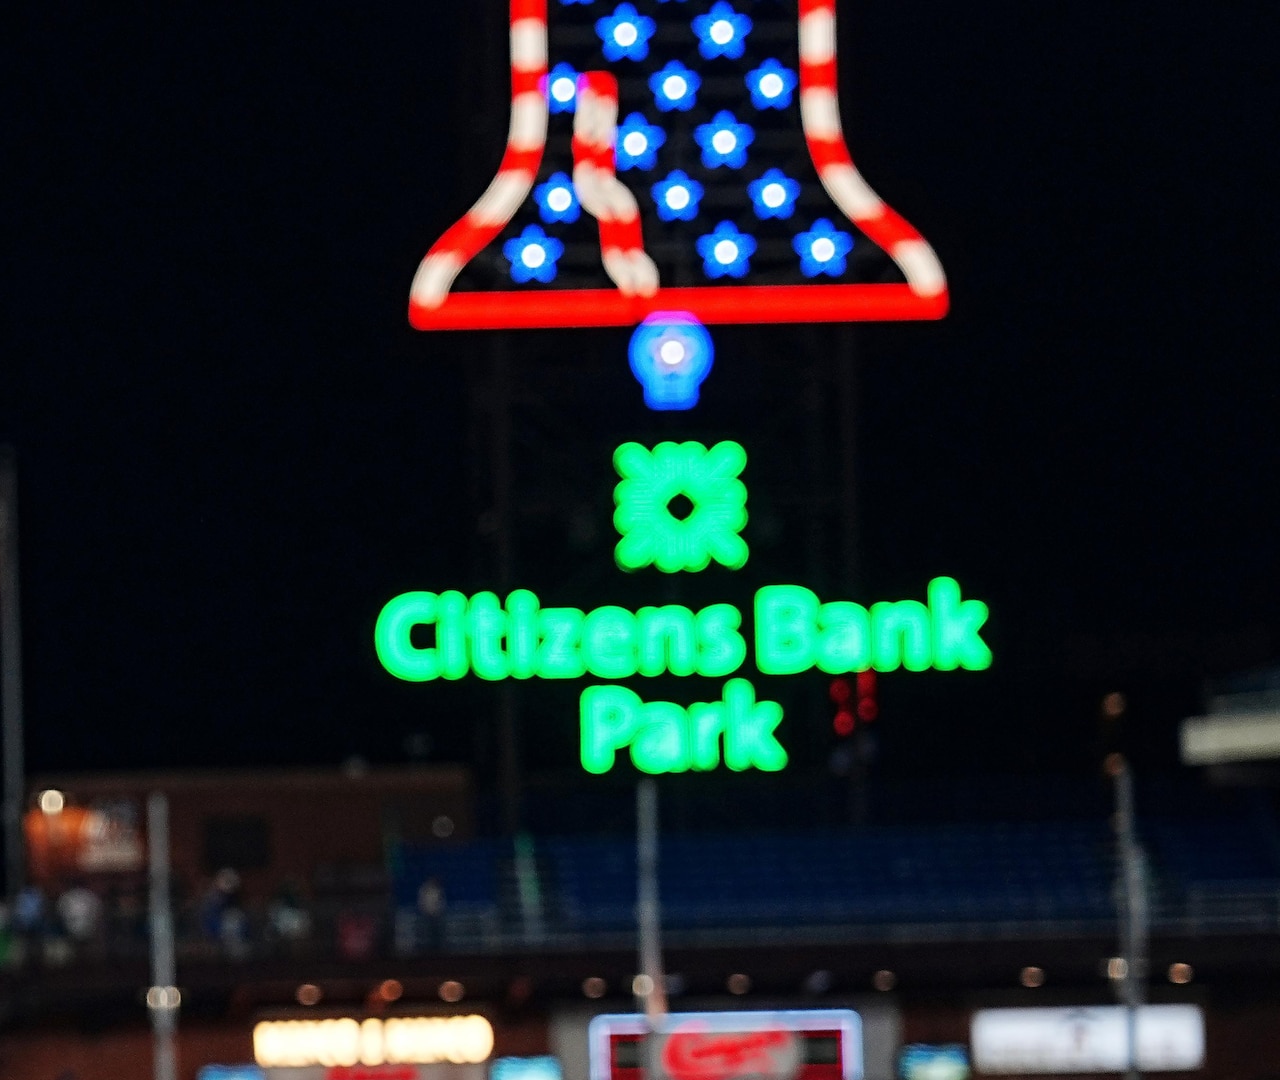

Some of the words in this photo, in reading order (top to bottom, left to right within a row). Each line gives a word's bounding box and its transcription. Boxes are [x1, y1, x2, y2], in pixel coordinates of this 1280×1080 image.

[374, 589, 745, 681] Citizens
[754, 576, 993, 674] Bank
[579, 678, 788, 774] Park
